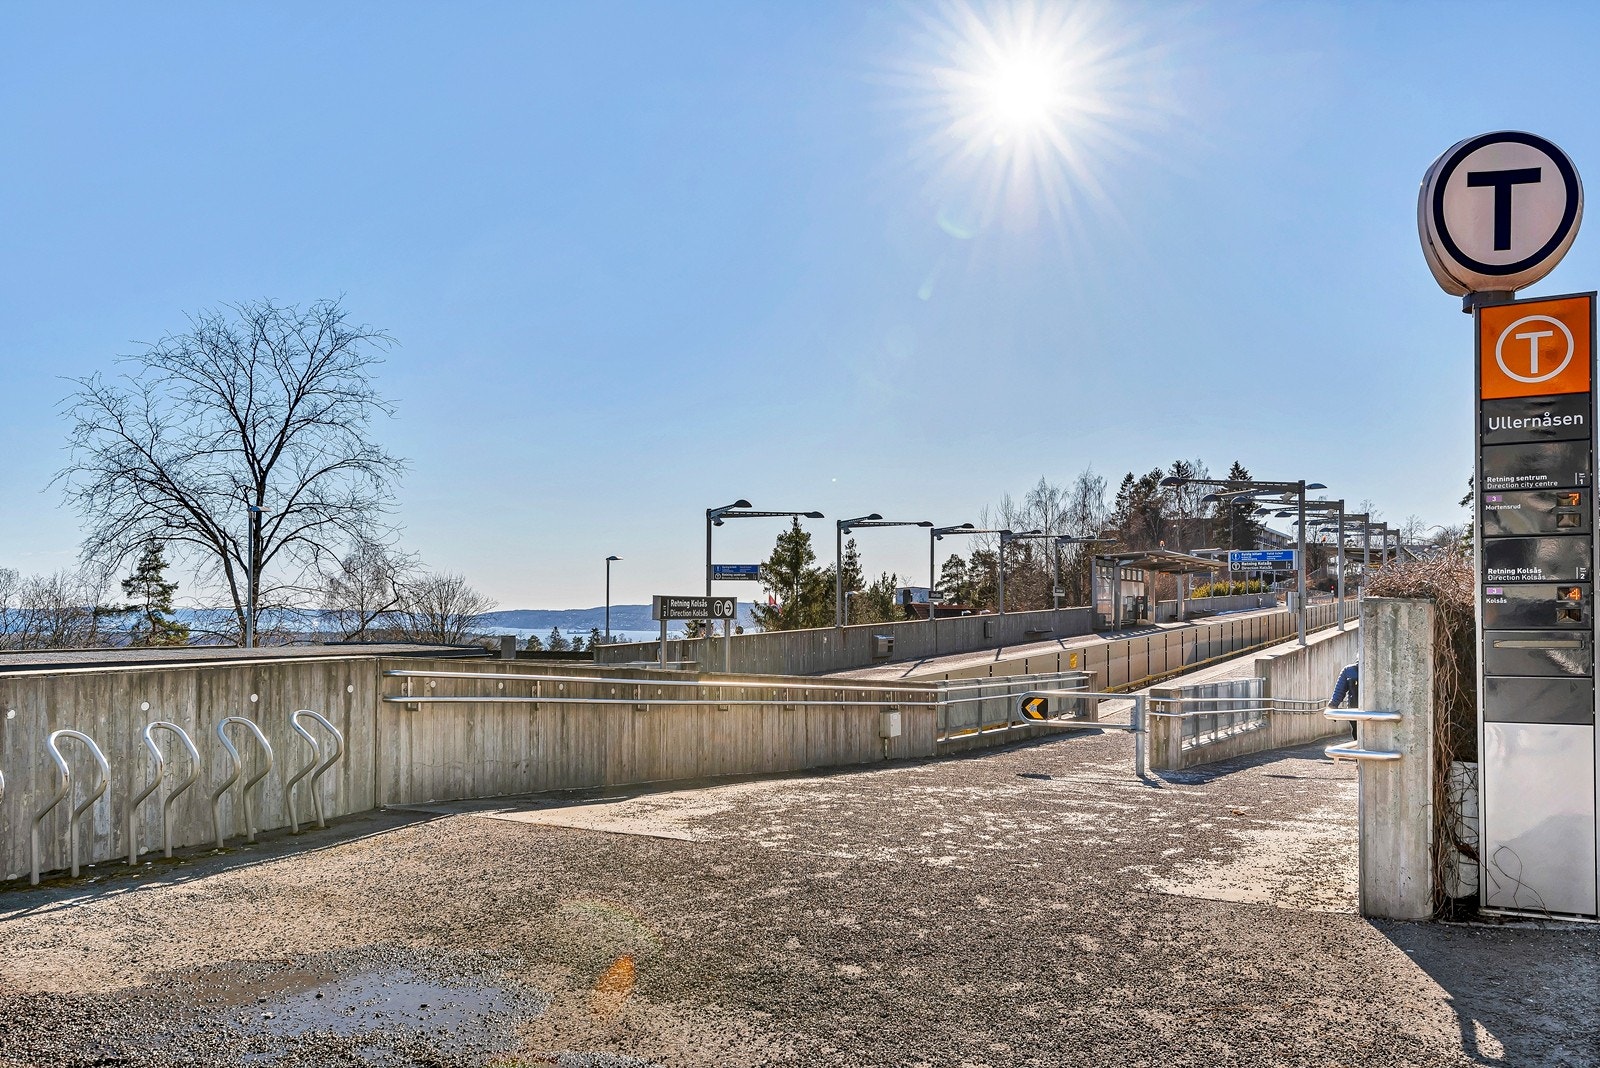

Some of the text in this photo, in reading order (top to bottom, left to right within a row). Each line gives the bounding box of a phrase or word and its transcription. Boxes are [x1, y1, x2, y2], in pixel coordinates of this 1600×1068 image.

[1467, 167, 1541, 250] T
[1515, 330, 1553, 374] T
[1488, 411, 1584, 430] Ullernåsen
[1520, 481, 1534, 489] city
[1568, 493, 1580, 506] 7
[1485, 503, 1521, 511] Mortensrud
[1517, 567, 1543, 575] Kolsås
[1568, 588, 1580, 601] 4
[670, 600, 690, 608] Retning
[691, 599, 708, 607] Kolsås
[670, 609, 709, 617] Direction Kolsås
